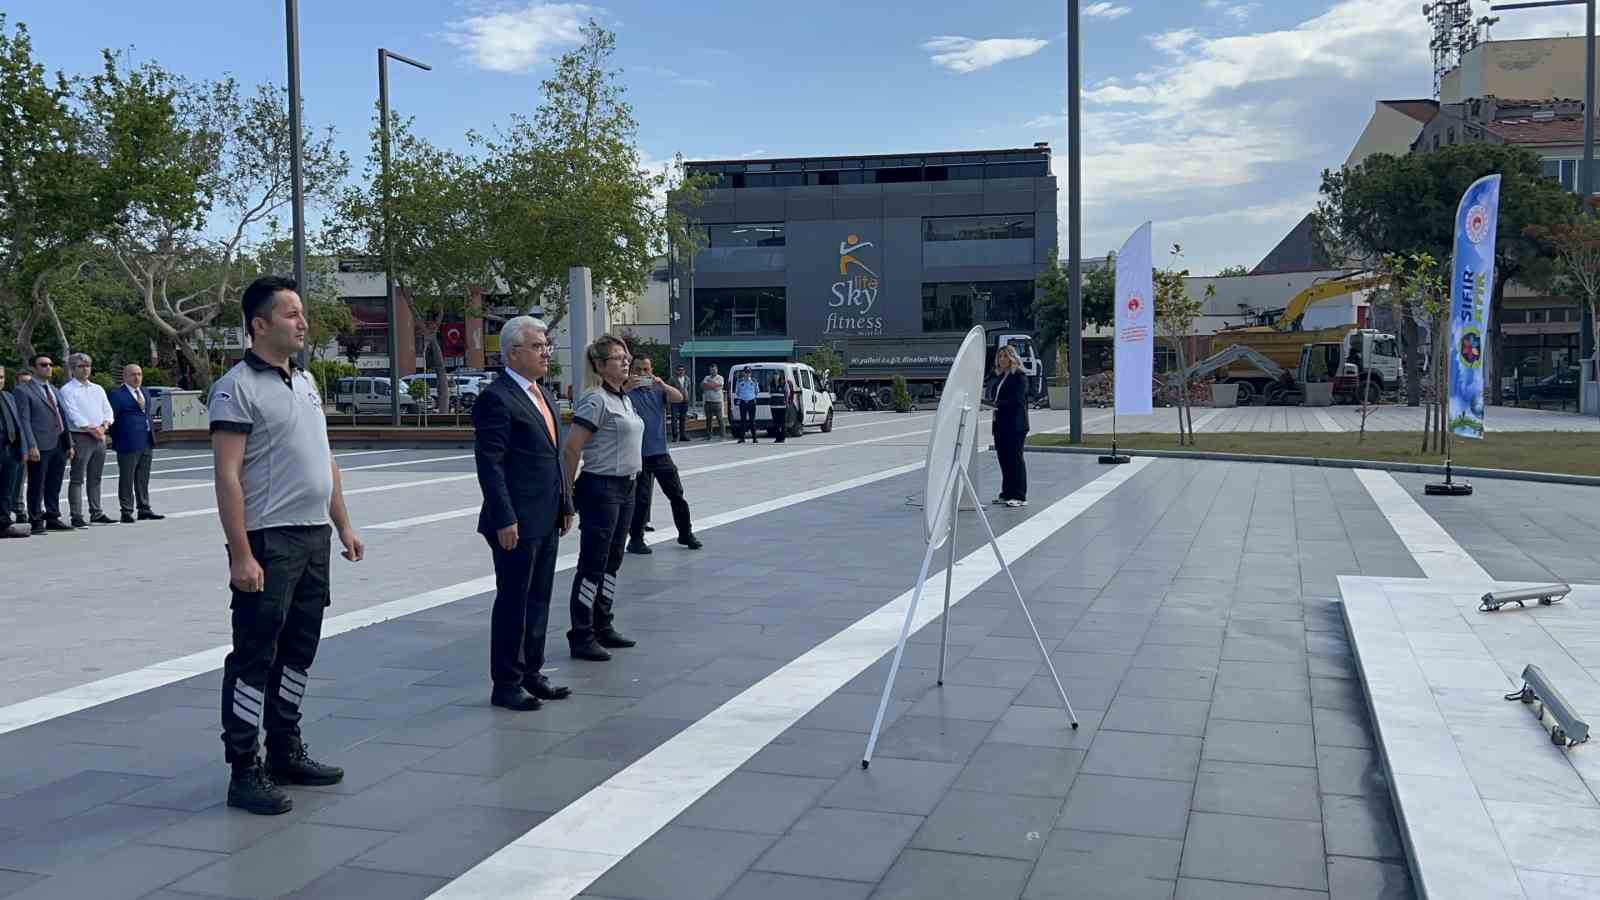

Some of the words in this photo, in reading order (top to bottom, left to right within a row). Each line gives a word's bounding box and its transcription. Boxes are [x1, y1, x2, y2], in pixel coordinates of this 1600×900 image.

[828, 280, 877, 314] Sky
[1461, 270, 1473, 322] SIFIR
[823, 313, 882, 334] fitness
